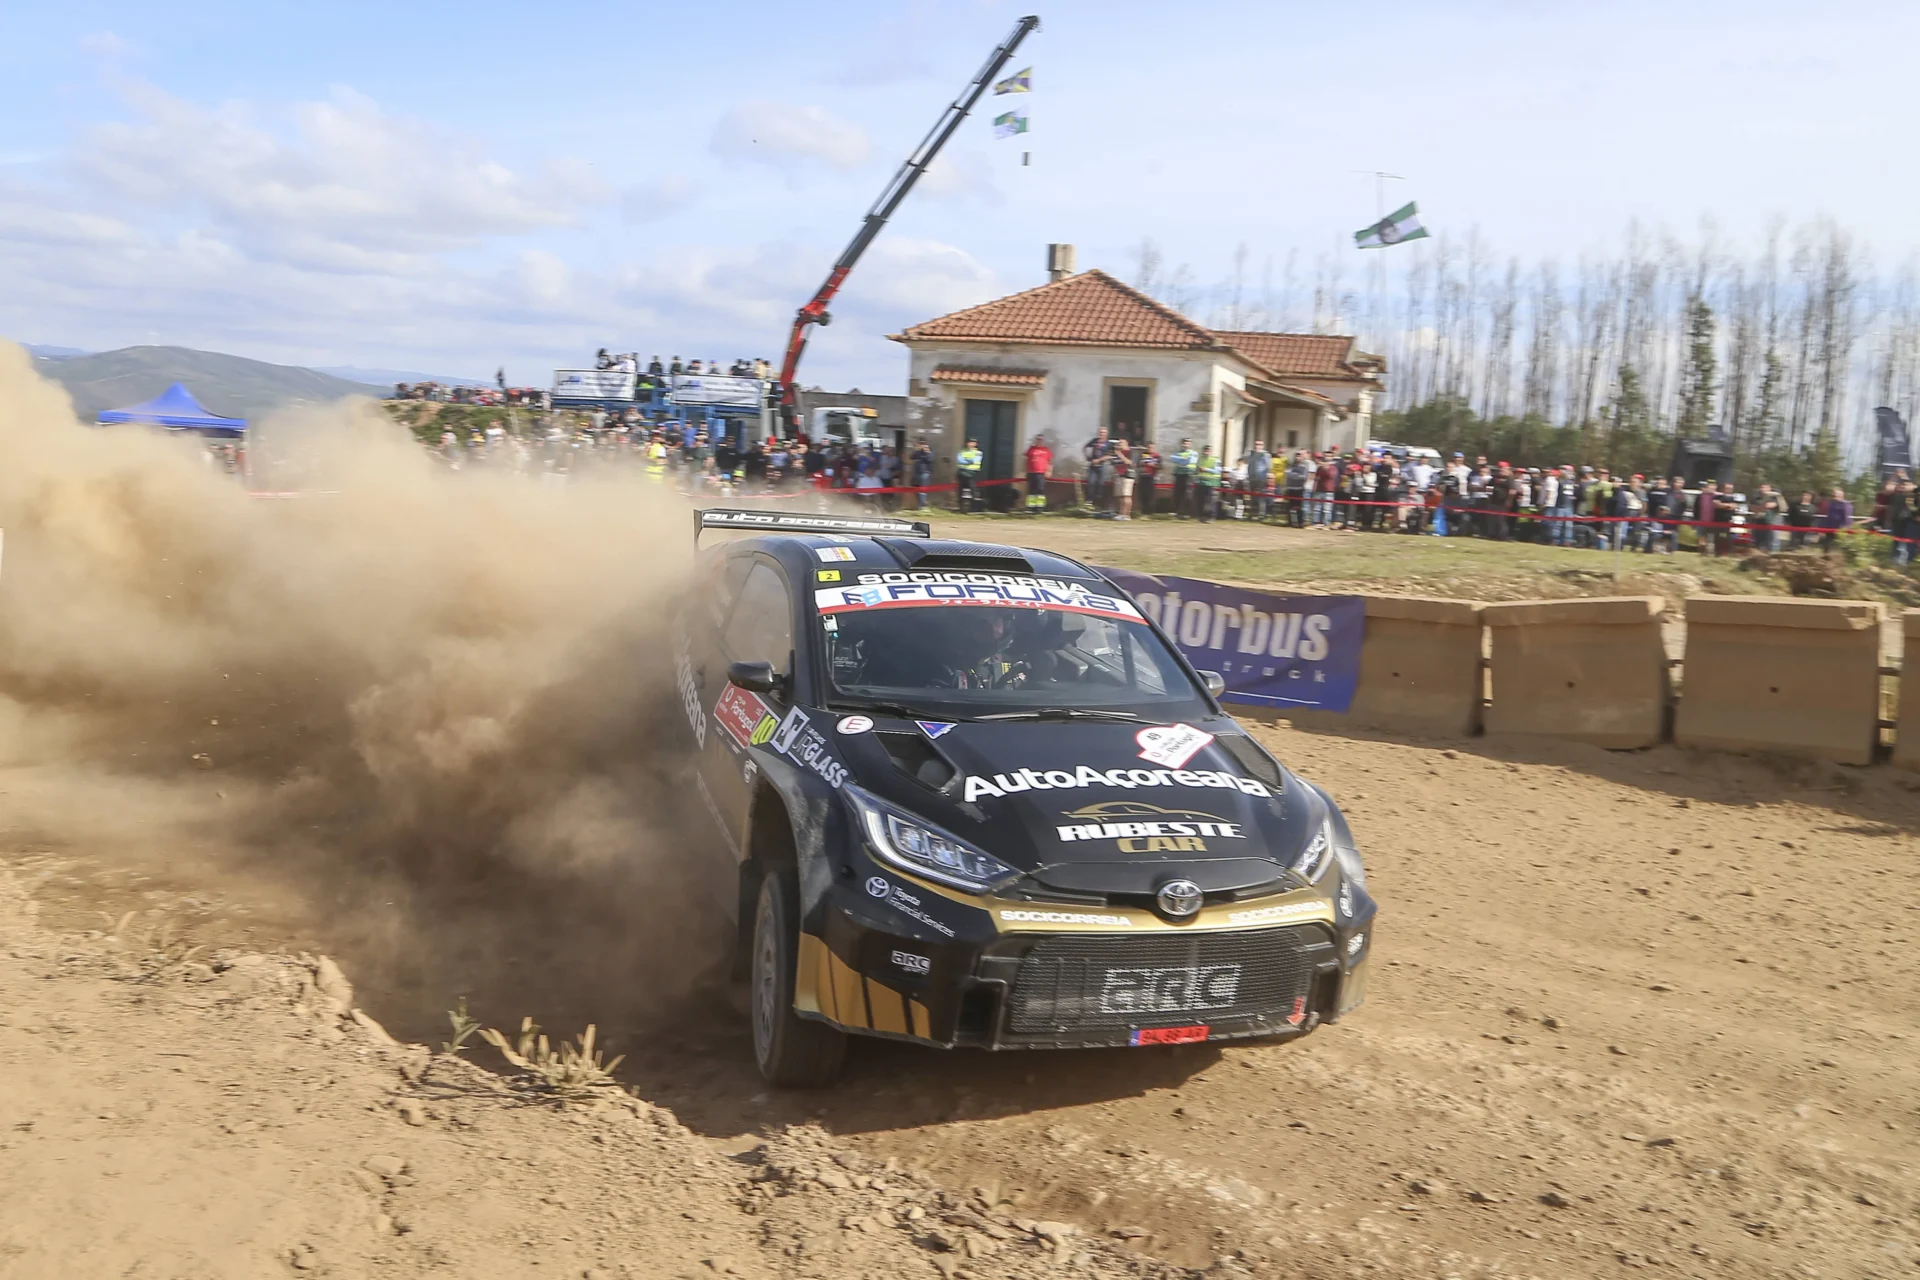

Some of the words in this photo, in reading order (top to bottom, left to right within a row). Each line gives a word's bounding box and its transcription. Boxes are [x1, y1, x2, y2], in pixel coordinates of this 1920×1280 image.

[856, 572, 1093, 594] SOCICORREIA
[887, 584, 1121, 612] FORUM8
[845, 718, 866, 731] E
[963, 765, 1273, 802] AutoAçoreana
[1056, 821, 1247, 842] RUBESTE
[1117, 836, 1208, 853] CAR
[894, 887, 920, 906] Toyota
[1000, 910, 1132, 926] SOCICORREIA
